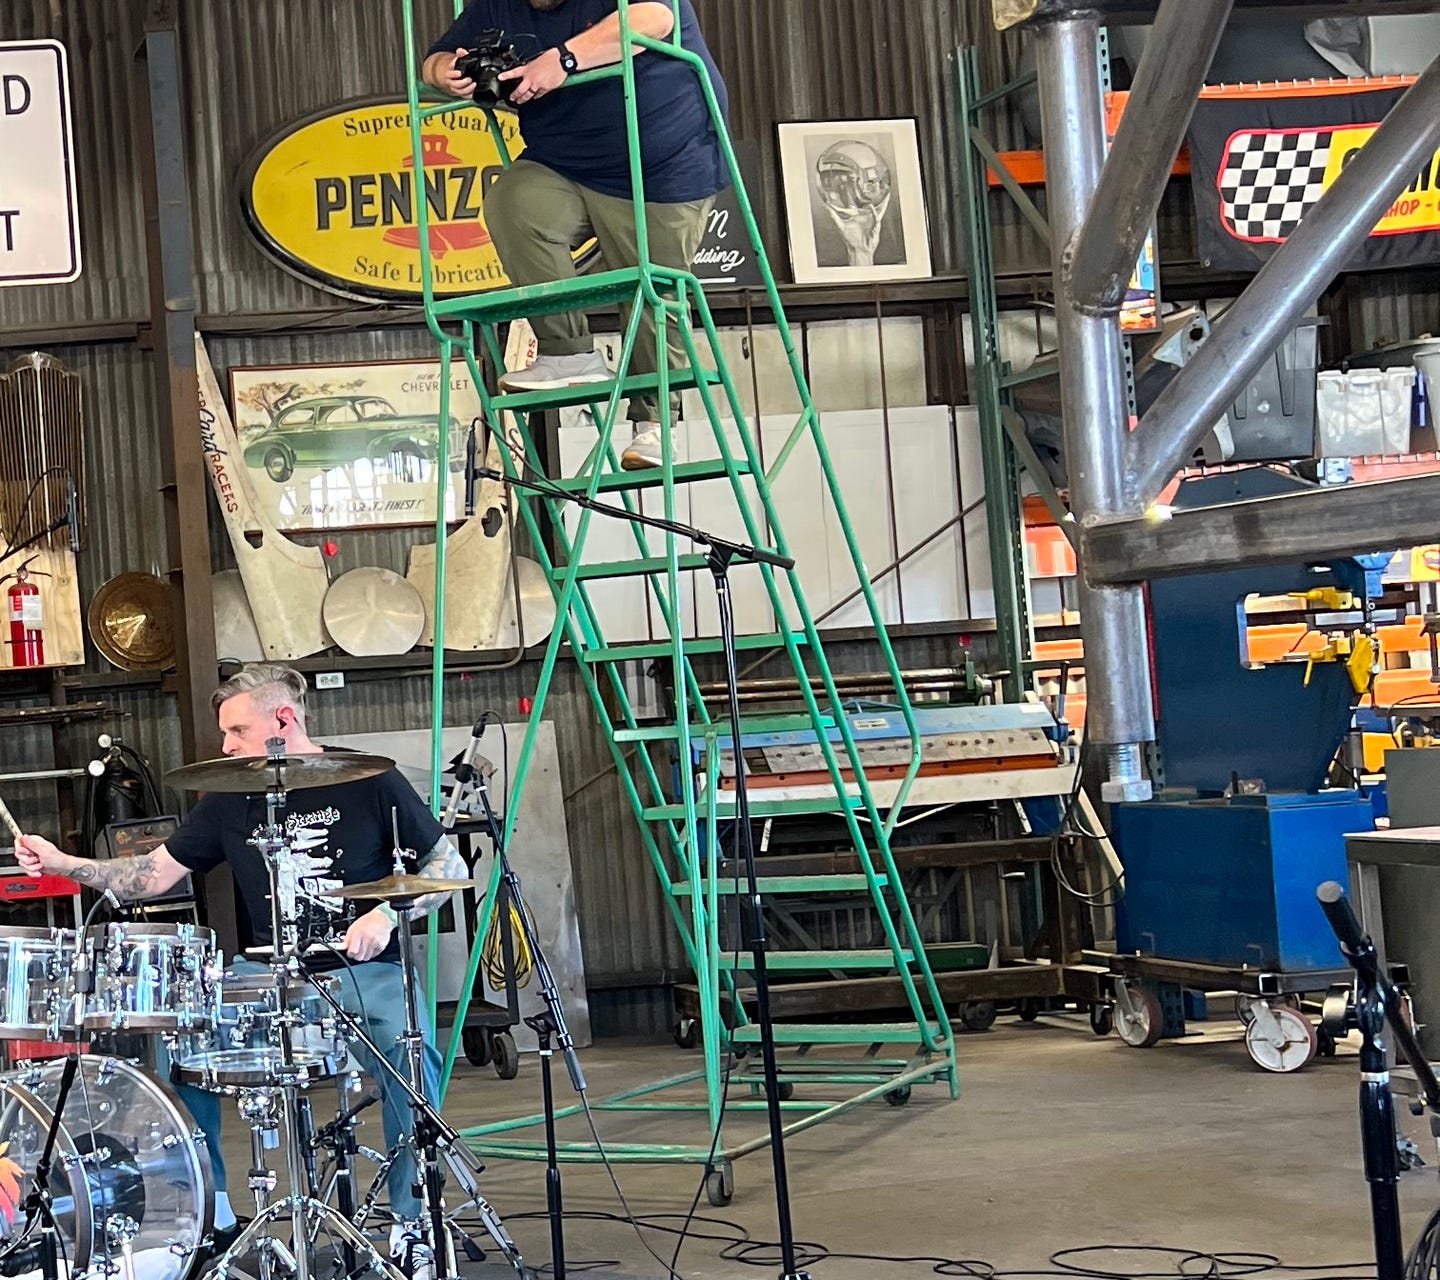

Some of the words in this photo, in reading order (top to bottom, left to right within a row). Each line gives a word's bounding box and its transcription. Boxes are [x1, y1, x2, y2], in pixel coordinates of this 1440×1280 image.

[344, 111, 434, 137] Supree
[441, 112, 519, 142] Qualty
[314, 164, 505, 231] PENNZ
[353, 255, 401, 281] Safe
[407, 259, 503, 285] Lbricati
[401, 380, 469, 393] CHEVRLET
[210, 453, 239, 514] RACERS
